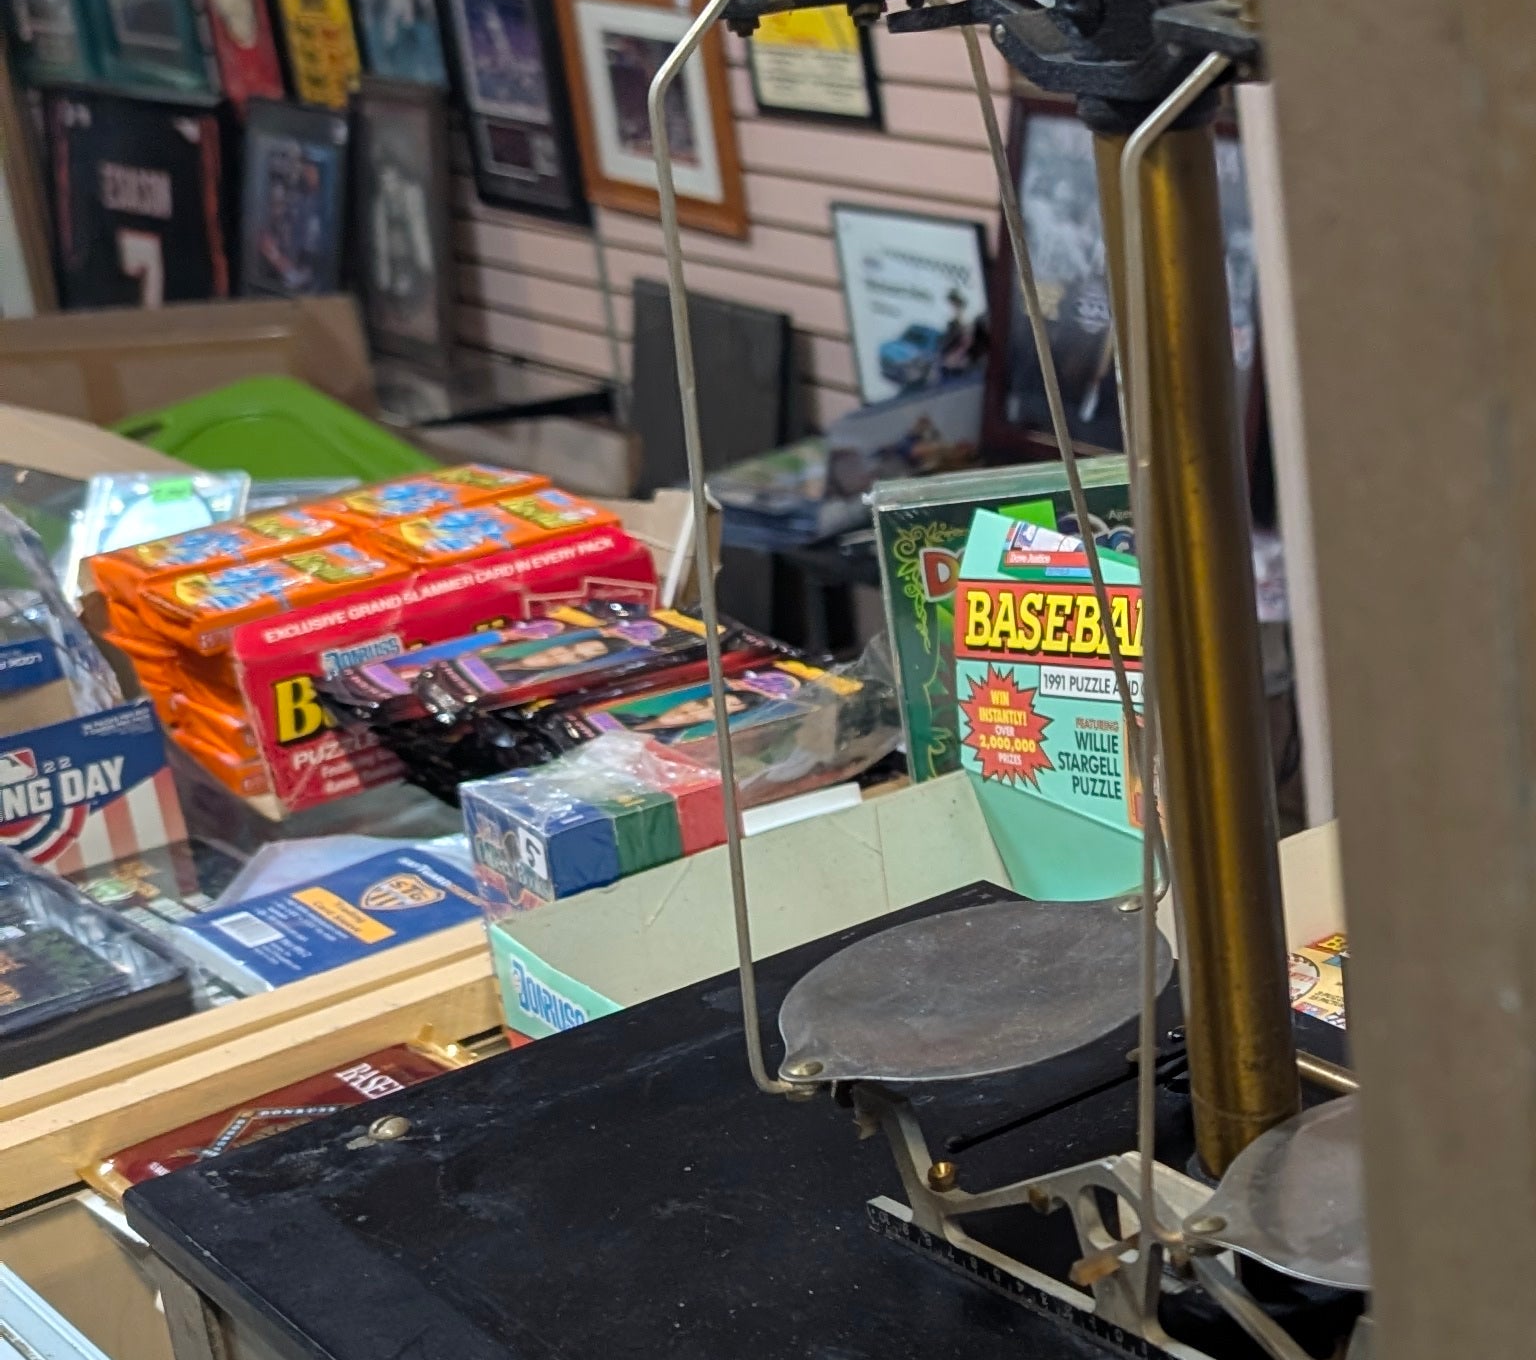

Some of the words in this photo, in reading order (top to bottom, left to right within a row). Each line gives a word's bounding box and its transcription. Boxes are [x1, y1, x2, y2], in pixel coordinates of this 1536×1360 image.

[263, 610, 348, 643] EXCLUSIVE
[347, 595, 400, 622] GRAND
[403, 571, 473, 604] SLAMMER
[474, 563, 513, 586] CARD
[514, 559, 530, 577] IN
[531, 548, 574, 571] EVERY
[577, 538, 615, 559] PACK
[965, 590, 1143, 656] BASEBA
[1044, 673, 1066, 689] 1991
[1069, 676, 1110, 694] PUZZLE
[990, 690, 1010, 706] WIN
[979, 707, 1027, 726] INSTANTLY!
[995, 726, 1015, 735] OVER
[979, 735, 1036, 753] 2,000,000
[1075, 731, 1119, 754] WILLIE
[1058, 752, 1121, 777] STARGELL
[0, 776, 53, 820] NG
[58, 755, 125, 806] DAY
[1072, 776, 1122, 800] PUZZLE
